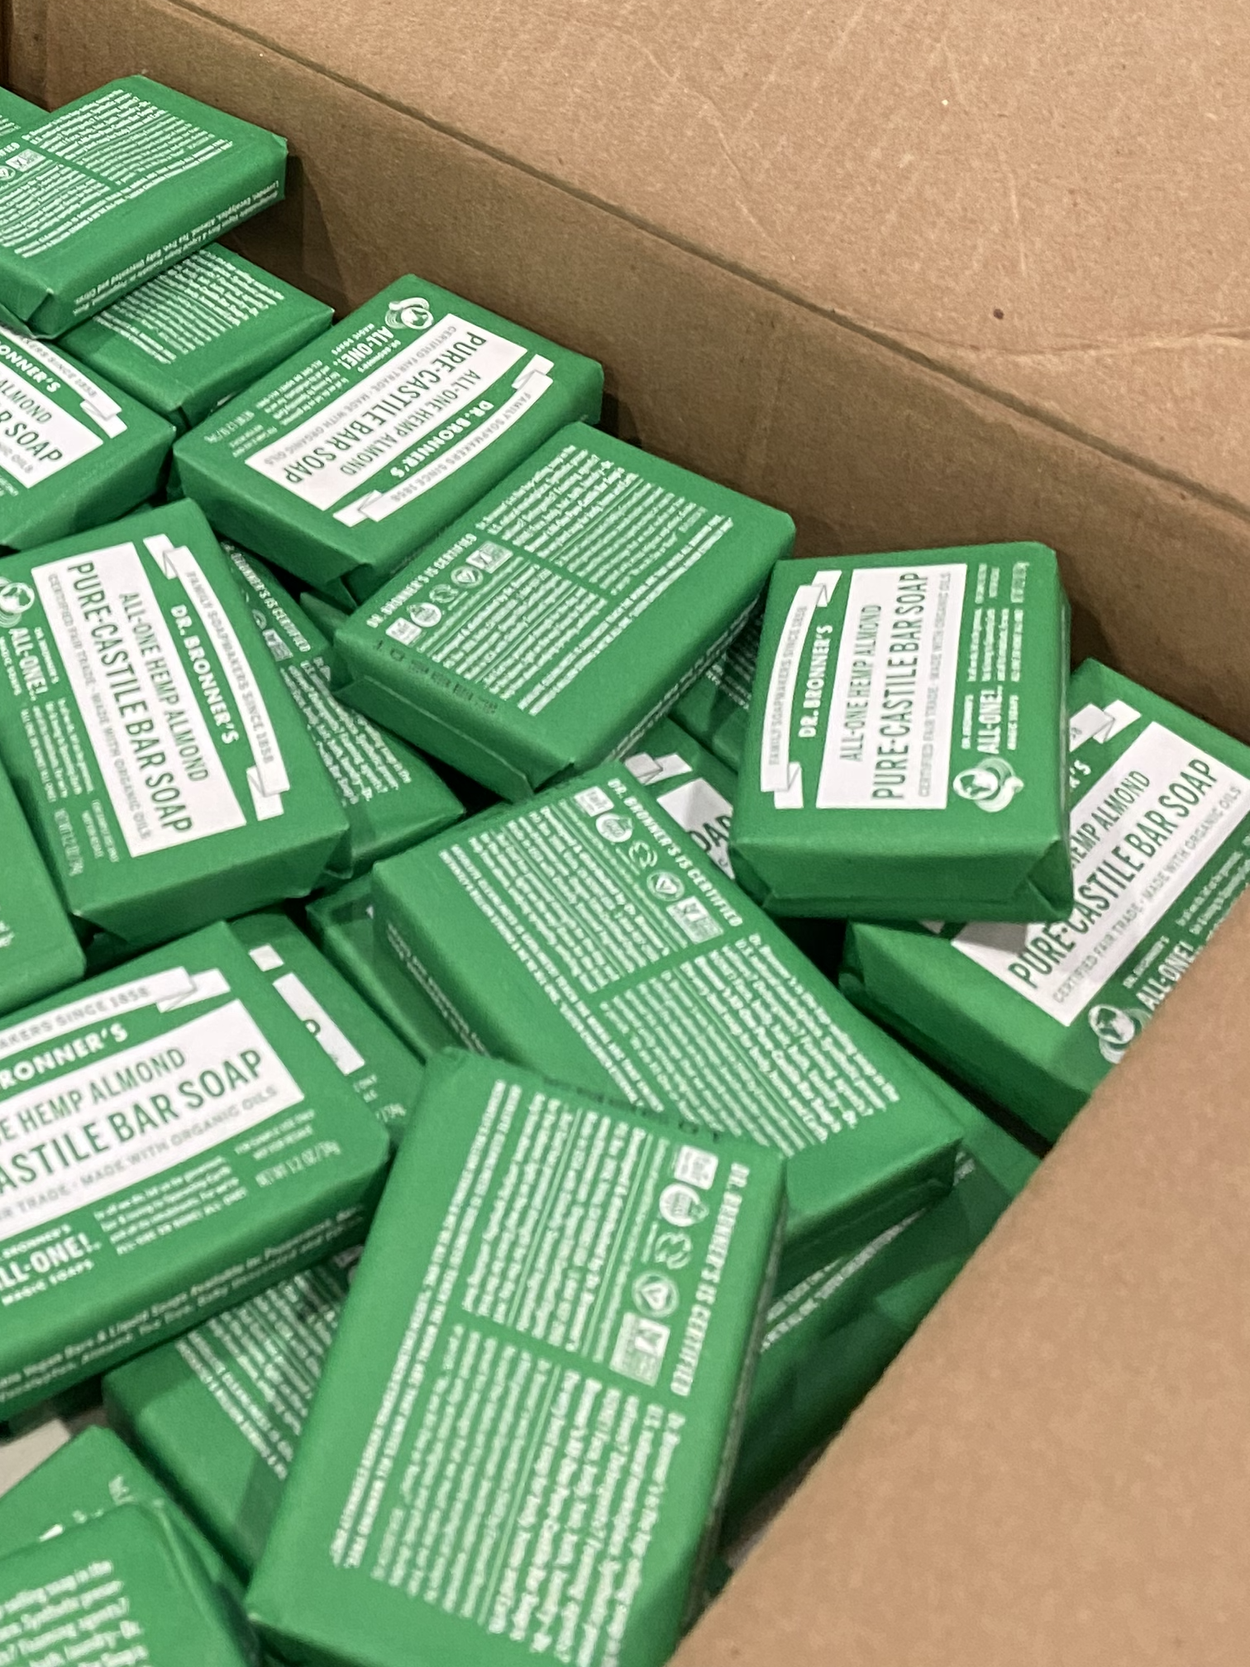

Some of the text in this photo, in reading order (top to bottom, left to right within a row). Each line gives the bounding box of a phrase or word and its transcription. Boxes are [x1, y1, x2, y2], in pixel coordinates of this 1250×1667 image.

[3, 421, 63, 462] SOAP
[281, 331, 487, 484] PURE-CASTILE BAR SOAP
[338, 369, 482, 476] ALL-ONE HEMP ALMOND
[388, 399, 494, 478] DR. BRONNER'S
[66, 561, 194, 833] PURE-CASTILE BAR SOAP
[118, 592, 209, 782] ALL-ONE HEMP ALMOND
[169, 604, 239, 744] DR. BRONNER'S
[798, 624, 833, 737] DR. BRONNER'S
[838, 604, 882, 761] ALL-ONE HEMP ALMOND
[872, 571, 928, 799] PURE-CASTILE BAR SOAP
[1070, 769, 1151, 869] EMP ALMOND
[1122, 809, 1178, 857] BAR
[1157, 757, 1218, 818] SOAP
[54, 998, 109, 1027] SINCE
[109, 985, 151, 1008] 1858
[16, 1088, 84, 1134] HEMP
[88, 1046, 187, 1104] ALMOND
[106, 1092, 180, 1143] BAR
[177, 1047, 262, 1110] SOAP
[15, 1182, 69, 1213] TRADE
[78, 1158, 126, 1187] MADE
[125, 1140, 169, 1166] WITH
[169, 1103, 241, 1146] ORGANIC
[240, 1084, 279, 1111] OILS
